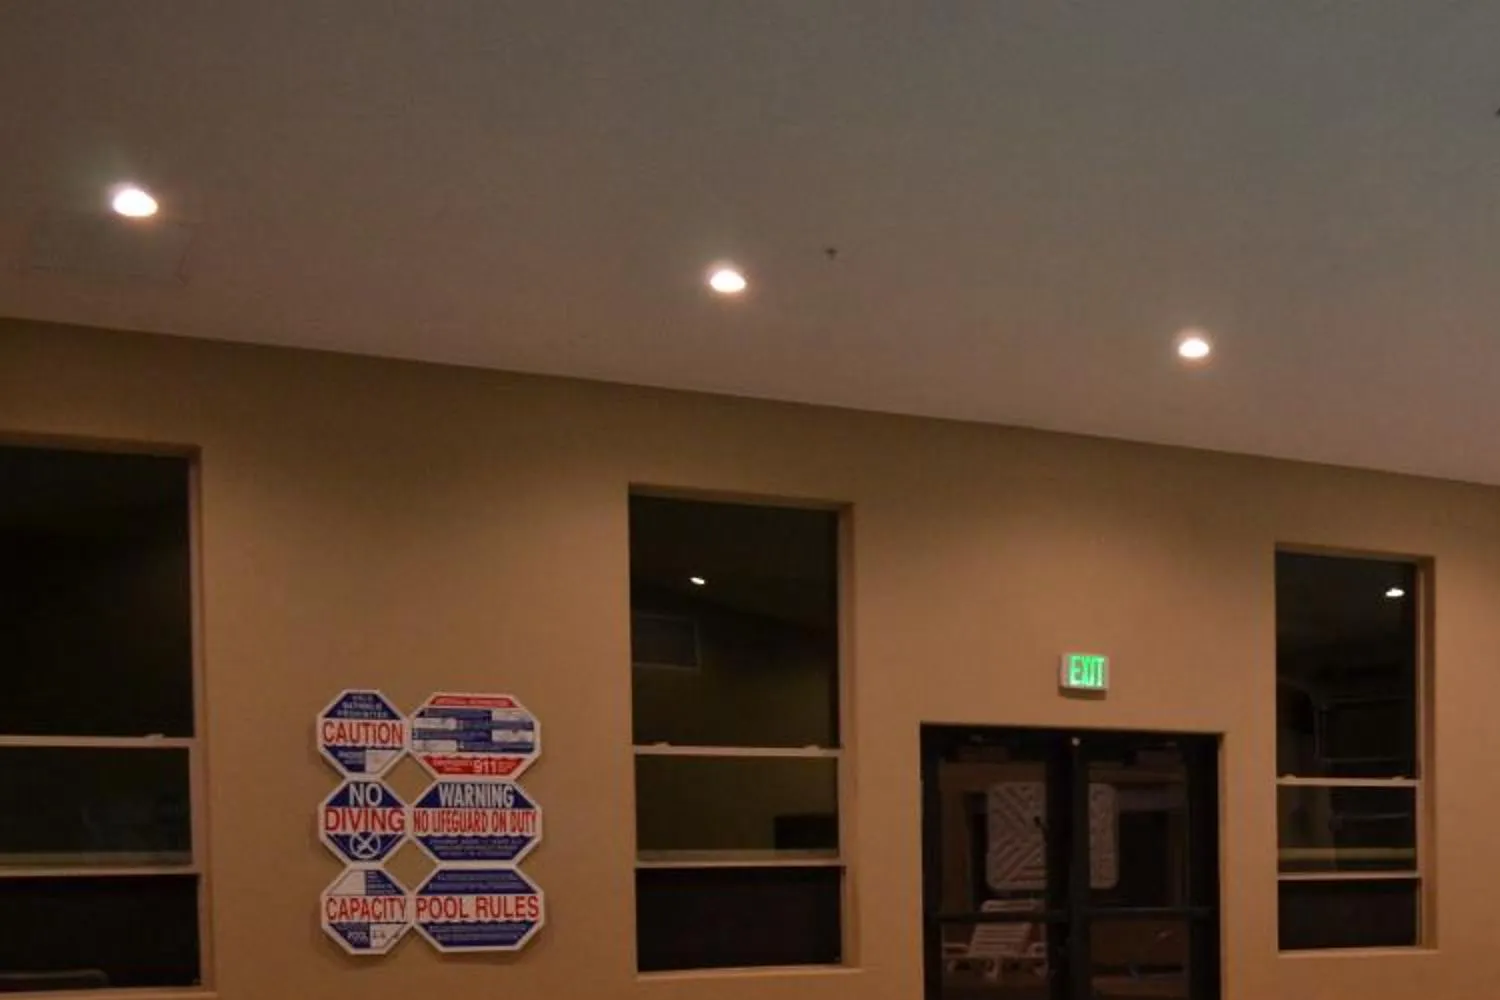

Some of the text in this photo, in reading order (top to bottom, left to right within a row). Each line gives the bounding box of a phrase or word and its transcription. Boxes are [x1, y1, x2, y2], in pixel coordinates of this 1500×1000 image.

[1070, 655, 1104, 686] EXIT
[323, 721, 403, 744] CAUTION
[473, 759, 497, 773] 911
[349, 783, 382, 807] NO
[439, 783, 514, 808] WARNING
[325, 807, 405, 832] DIVING
[413, 809, 536, 832] NO LIFEGUARD ON DUTY
[326, 897, 406, 920] CAPACITY
[416, 896, 539, 919] POOL RULES
